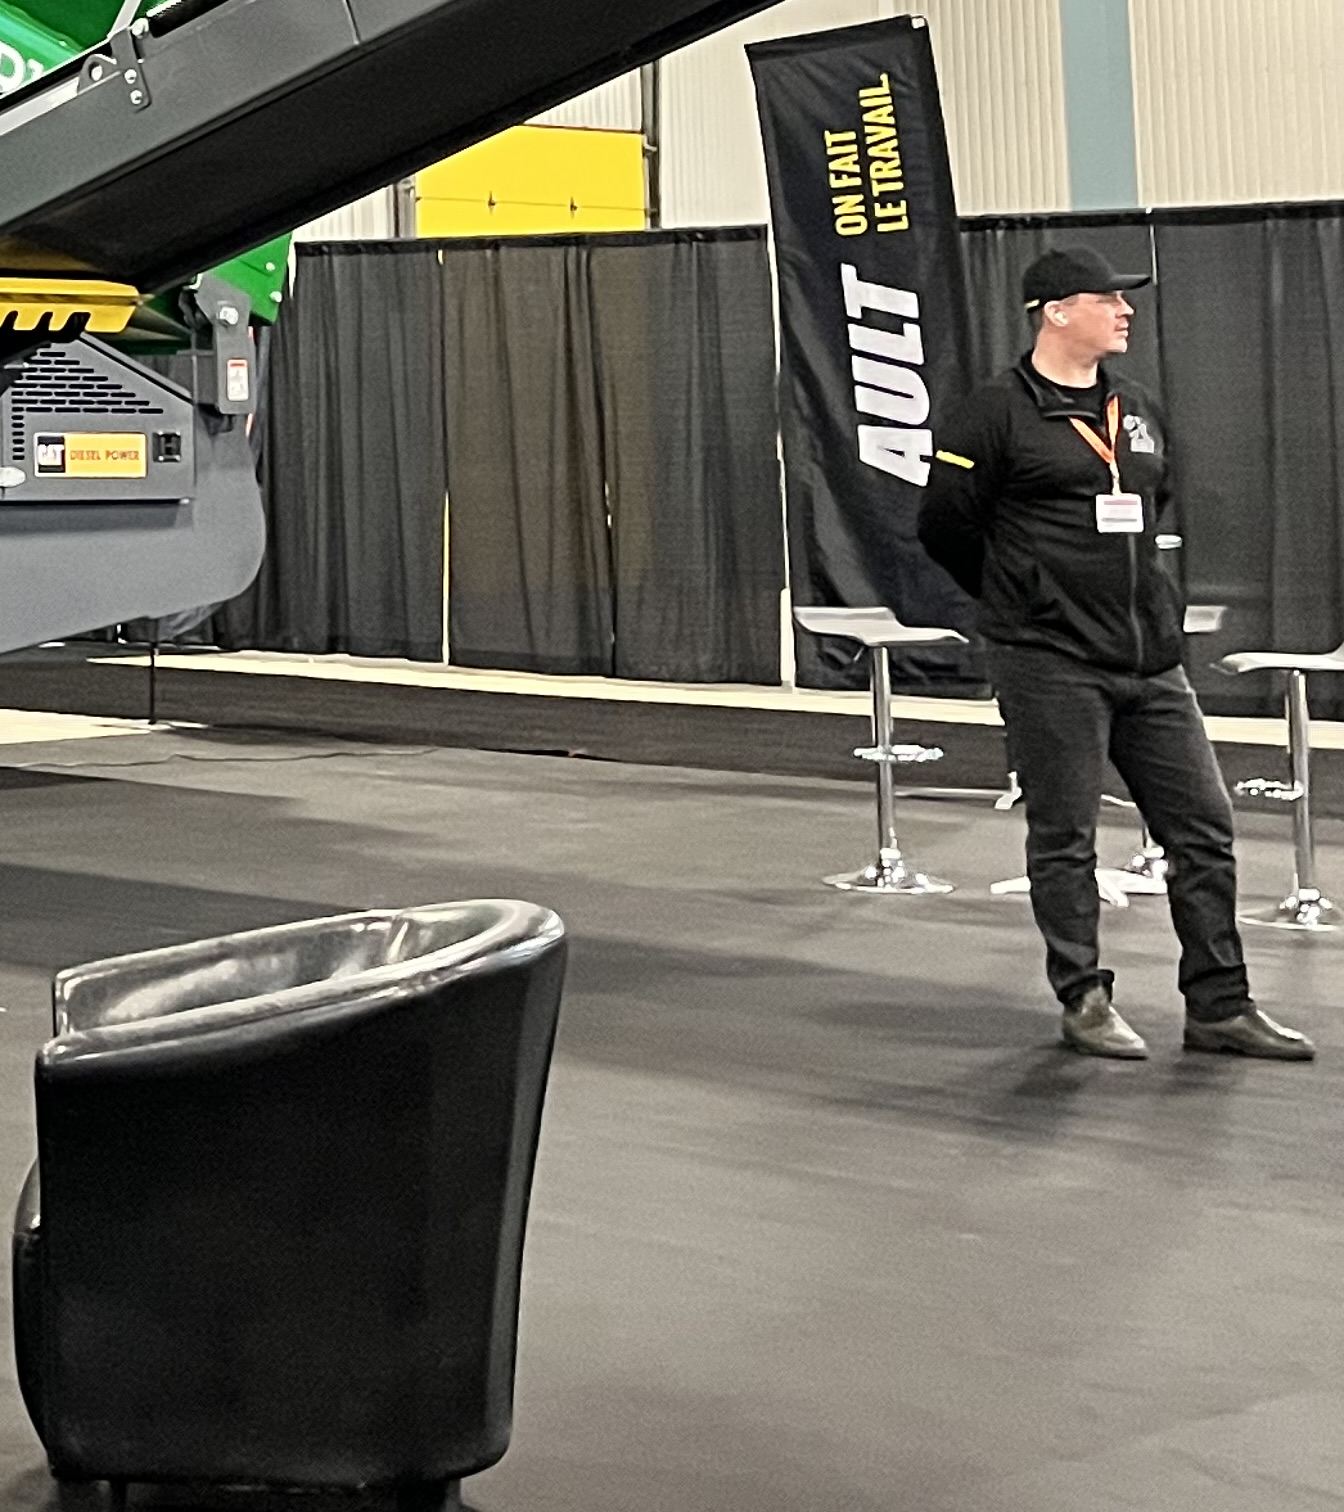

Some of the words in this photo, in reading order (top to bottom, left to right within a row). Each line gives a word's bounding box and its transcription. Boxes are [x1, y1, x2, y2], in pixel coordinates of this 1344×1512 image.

[824, 130, 863, 189] FAIT
[858, 72, 905, 198] TRAVAIL.
[831, 193, 869, 237] ON
[874, 199, 910, 233] LE
[840, 261, 934, 488] AULT
[70, 450, 101, 461] DIESEL
[105, 450, 140, 461] POWER
